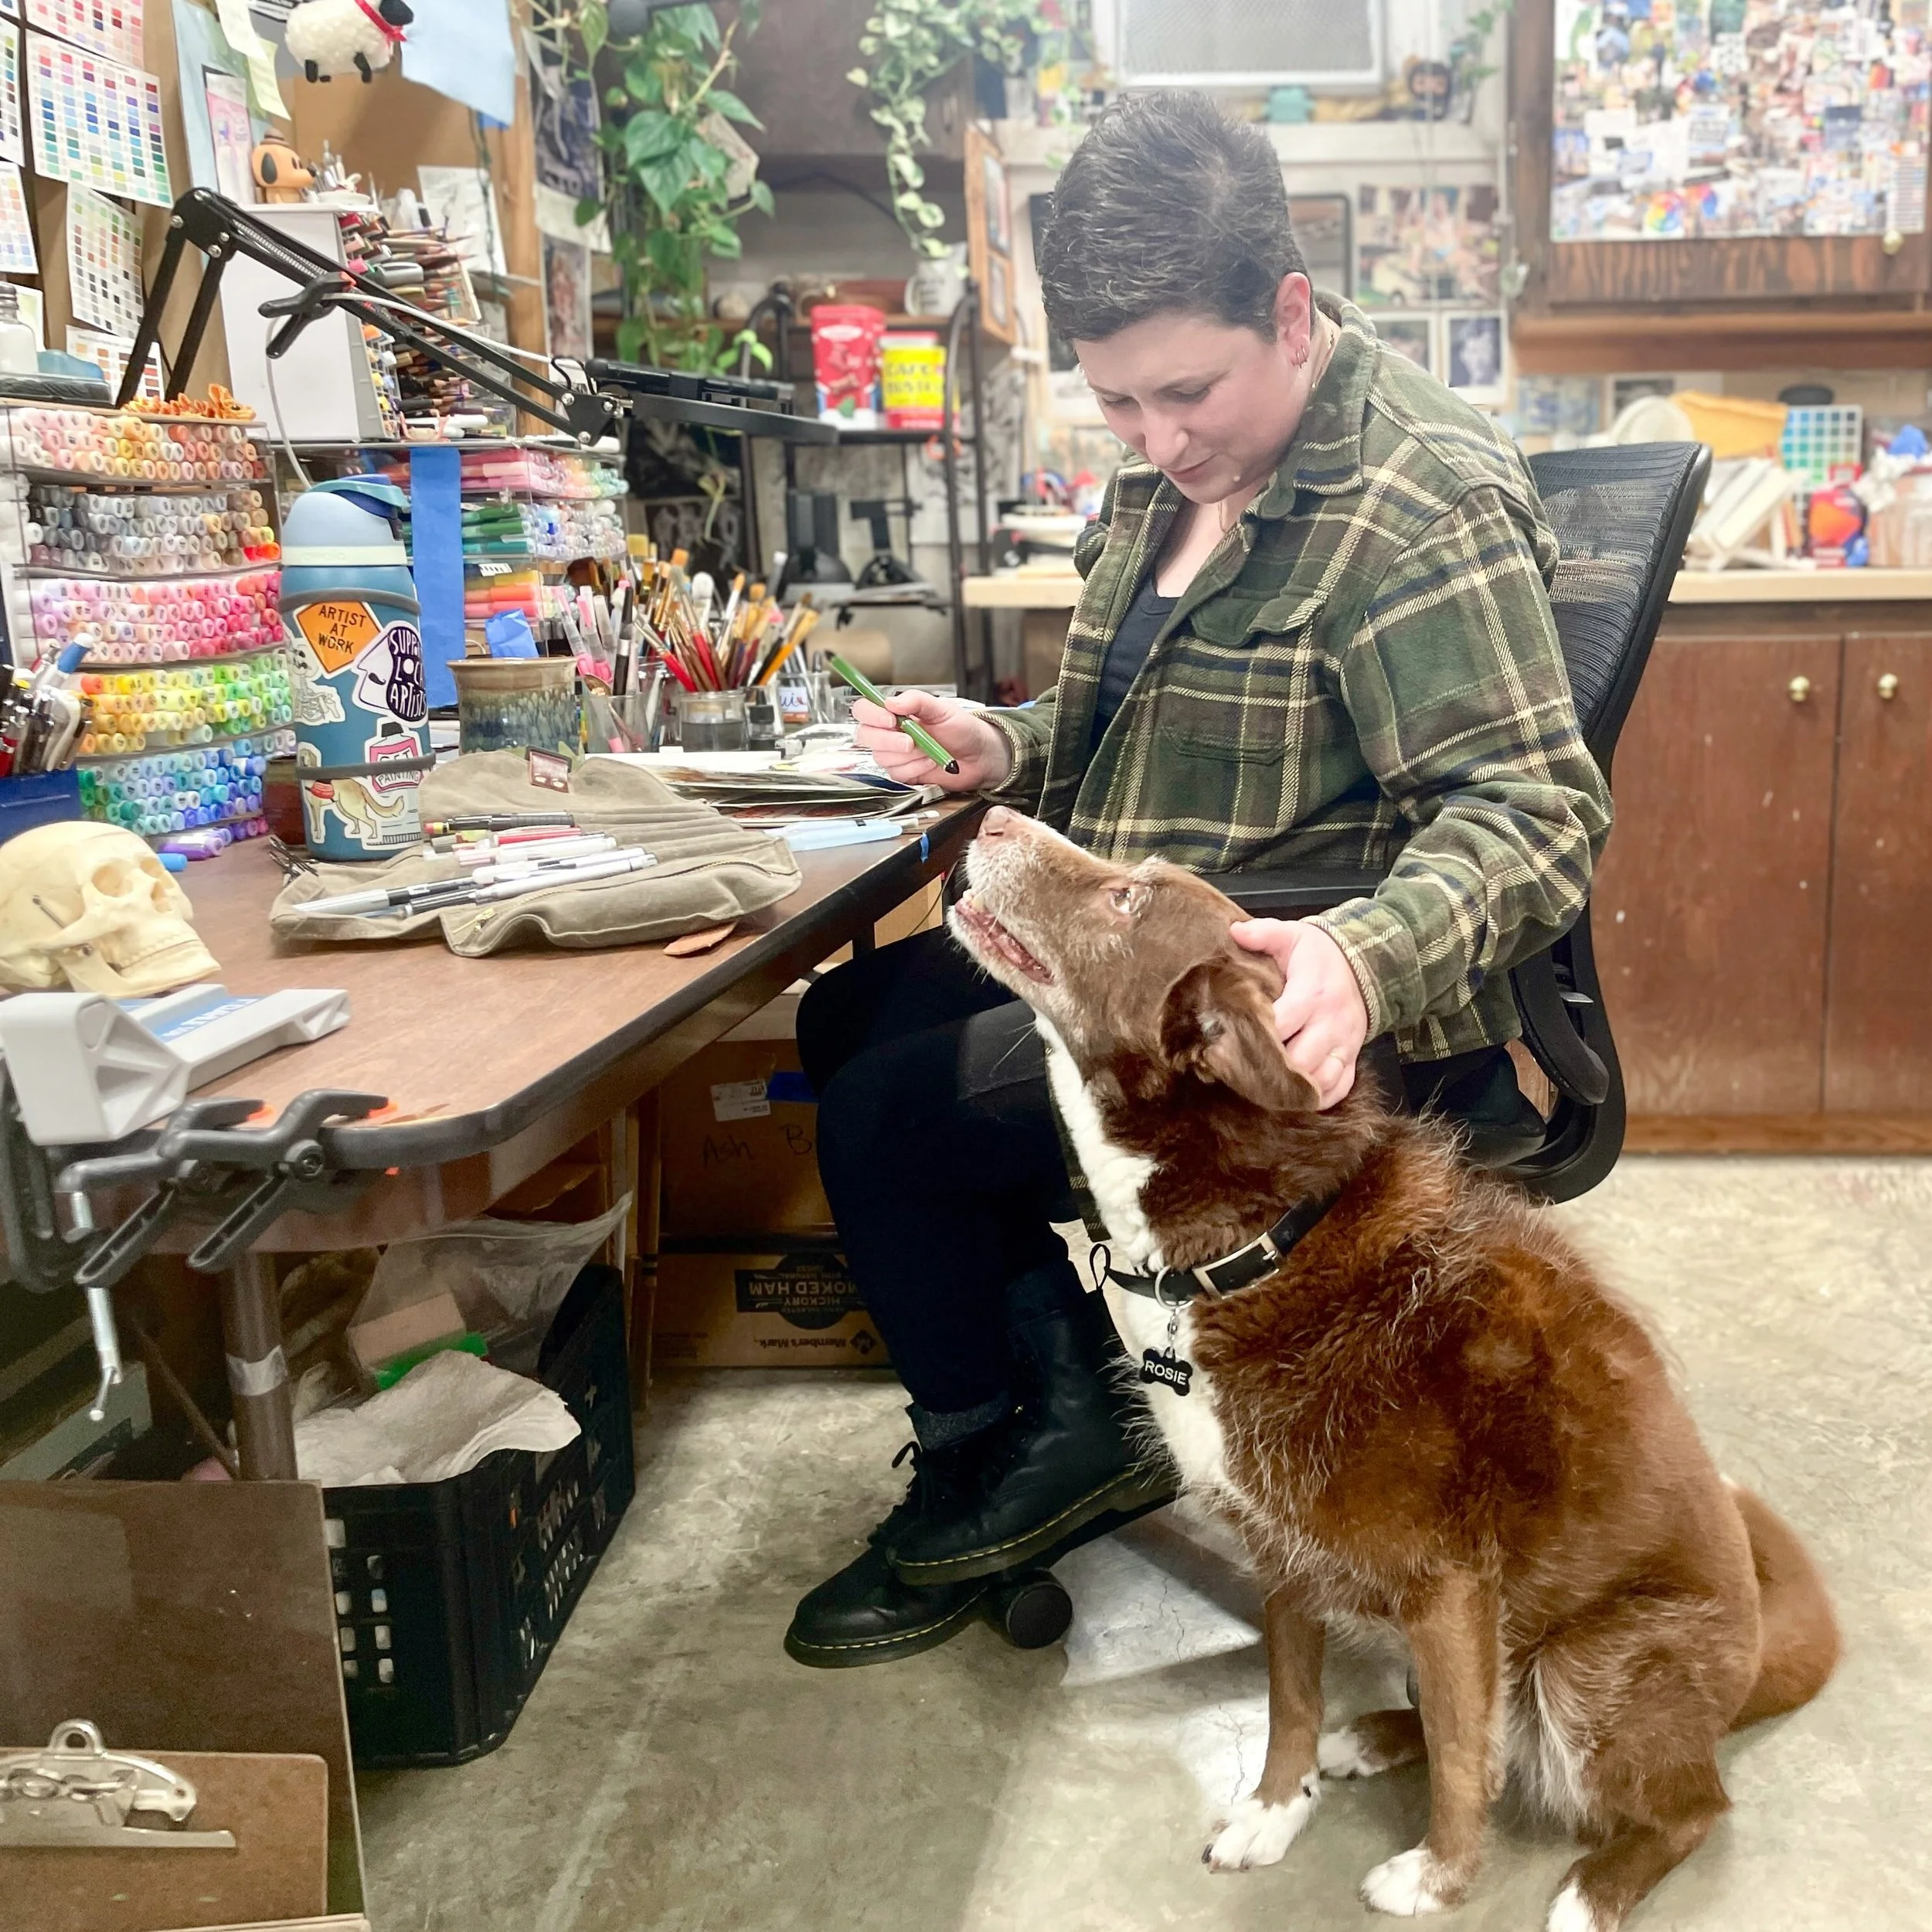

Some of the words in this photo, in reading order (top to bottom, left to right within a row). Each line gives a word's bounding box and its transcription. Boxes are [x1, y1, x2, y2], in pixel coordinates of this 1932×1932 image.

[318, 604, 367, 628] ARTIST
[330, 623, 349, 637] AT
[318, 633, 355, 655] WORK
[389, 629, 422, 657] SUPPO
[395, 656, 423, 688] LOCA
[378, 771, 419, 786] PAINTING
[702, 1131, 755, 1170] Ash
[747, 1281, 790, 1296] HAM
[795, 1281, 859, 1295] MOKED
[783, 1297, 841, 1306] HICKORY
[759, 1338, 789, 1349] Mark
[791, 1338, 847, 1349] Member's
[1145, 1360, 1188, 1386] ROSIE
